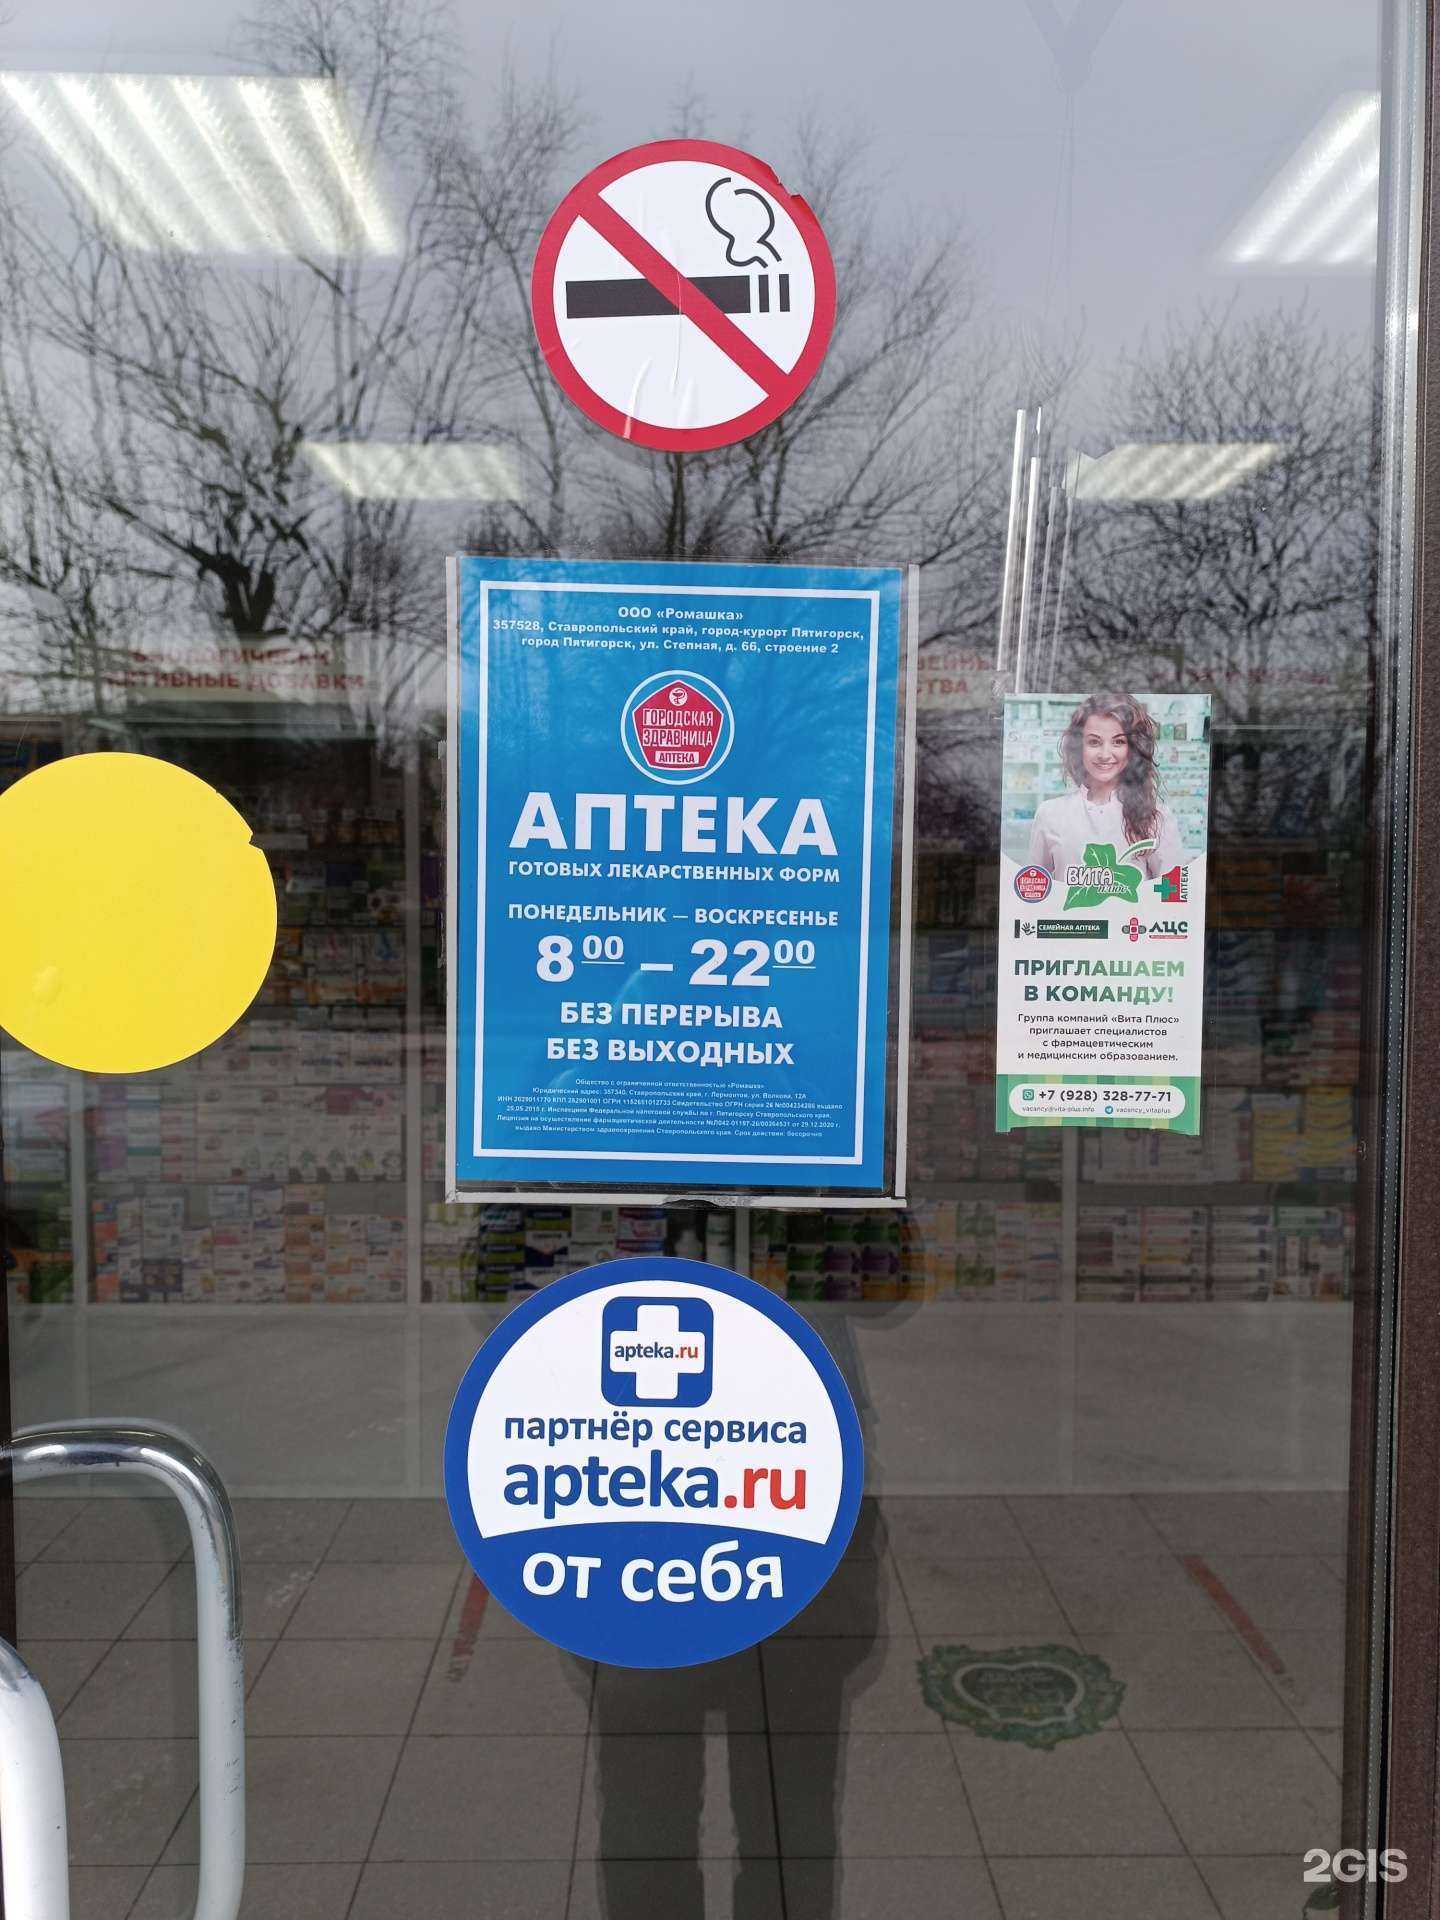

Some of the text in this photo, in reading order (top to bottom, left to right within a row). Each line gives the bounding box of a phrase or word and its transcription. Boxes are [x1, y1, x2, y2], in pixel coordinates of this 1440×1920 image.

[618, 606, 744, 621] ООО «Ромашка»
[492, 619, 864, 642] 357528, Ставропольский край, город-курорт Пятигорск,
[521, 635, 839, 655] город Пятигорск, ул. Степная, д. 66, строение 2
[643, 708, 714, 727] ГОРОДСКАЯ
[642, 729, 714, 747] ЗДРАВНИЦА
[658, 752, 695, 763] АПТЕКА
[508, 791, 839, 857] АПТЕКА
[508, 860, 841, 884] ГОТОВЫХ ЛЕКАРСТВЕННЫХ ФОРМ
[1066, 865, 1114, 886] ВИТА
[507, 903, 667, 924] ПОНЕДЕЛЬНИК
[694, 907, 840, 927] ВОСКРЕСЕНЬЕ
[1038, 922, 1101, 932] СЕМЕЙНАЯ АПТЕКА
[1014, 959, 1185, 978] ПРИГЛАШАЕМ
[1023, 985, 1174, 1006] В КОМАНДУ!
[560, 1000, 783, 1029] БЕЗ ПЕРЕРЫВА
[1017, 1012, 1180, 1026] Группа компаний «Вита Плюс»
[1029, 1026, 1168, 1039] приглашает специалистов
[546, 1037, 796, 1067] БЕЗ ВЫХОДНЫХ
[1042, 1038, 1153, 1051] с фармацевтическим
[1027, 1051, 1097, 1062] медицинским
[1100, 1050, 1178, 1063] образованием.
[1038, 1088, 1172, 1103] +7 (928) 328-77-71
[613, 1341, 699, 1362] apteka.ru
[503, 1411, 808, 1449] партнёр сервиса
[503, 1449, 807, 1520] apteka.ru
[522, 1538, 784, 1603] от себя
